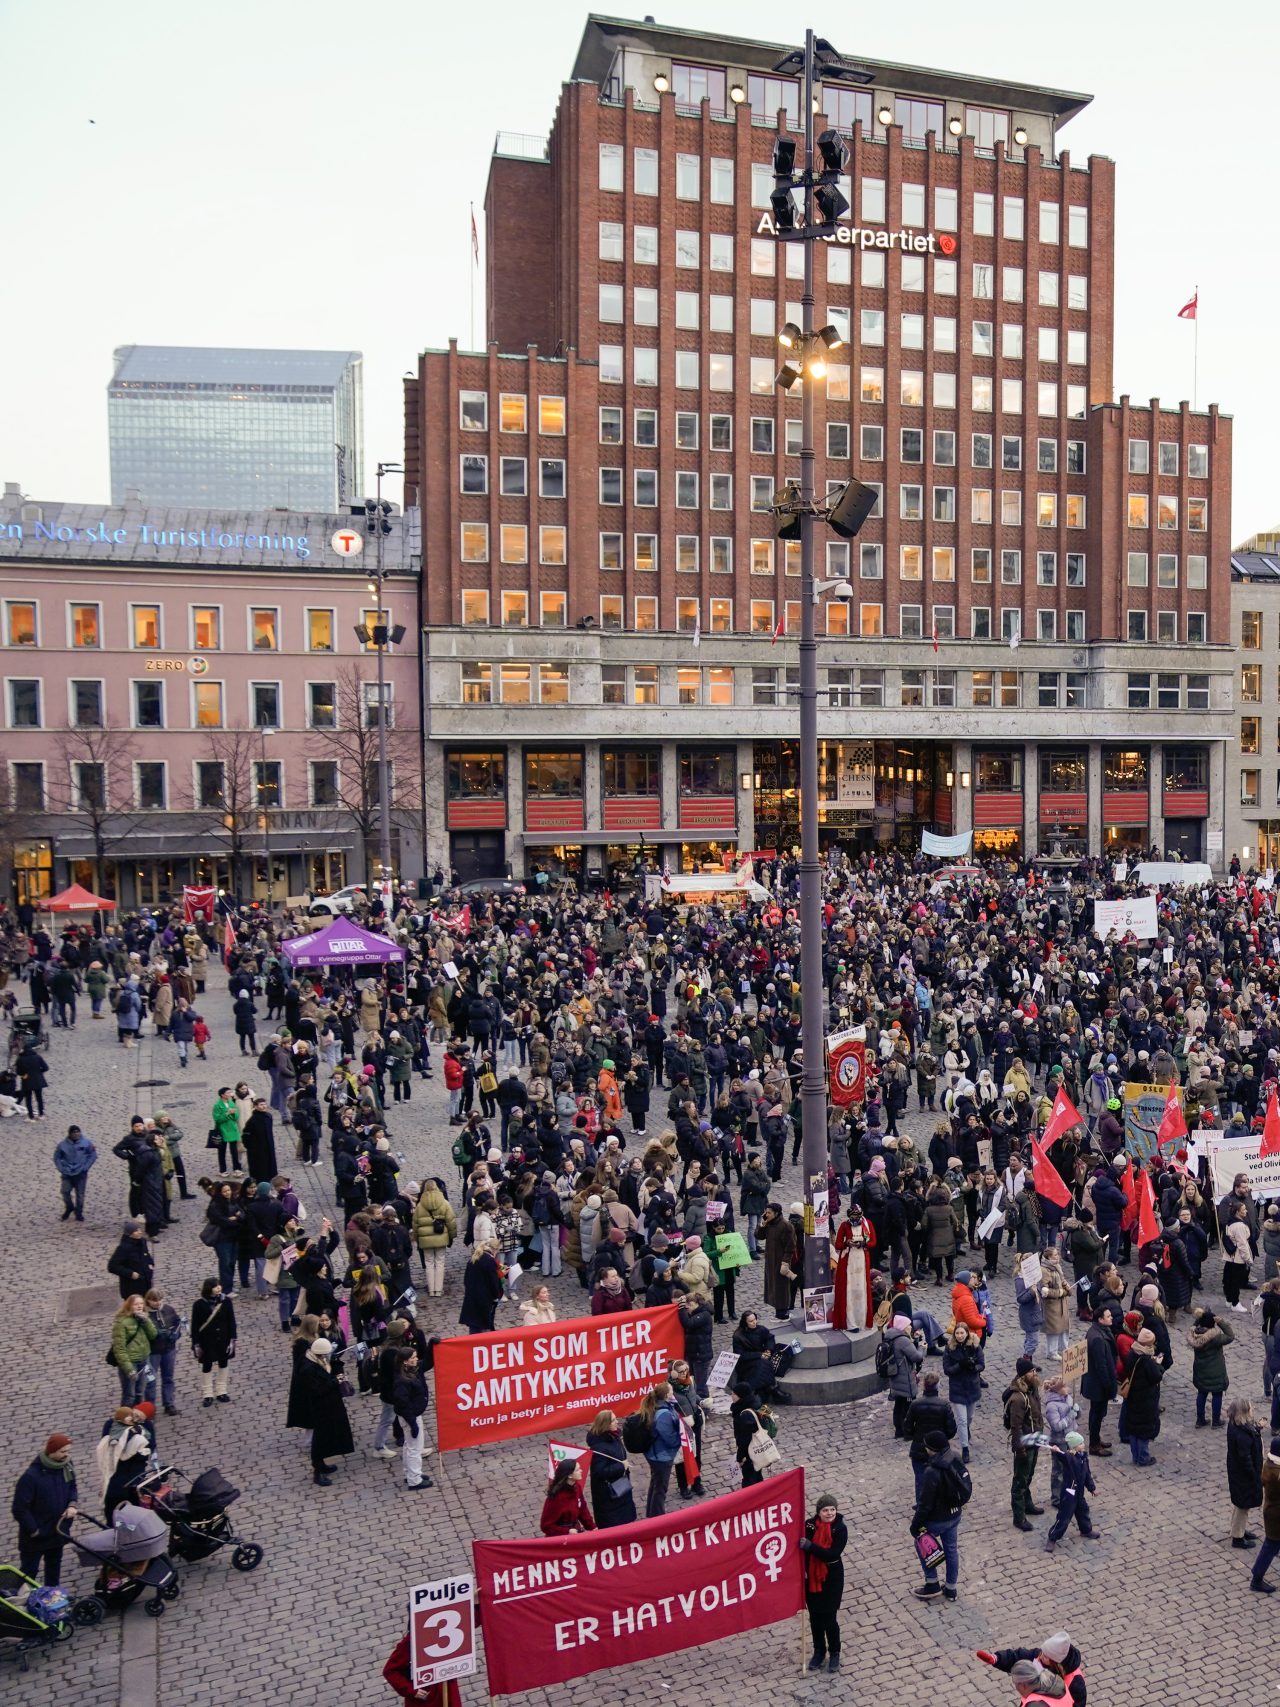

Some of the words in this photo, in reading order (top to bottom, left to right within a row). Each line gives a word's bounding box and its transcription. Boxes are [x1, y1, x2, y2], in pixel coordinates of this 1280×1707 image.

[756, 212, 936, 253] Aerpartiet
[35, 520, 127, 544] Norske
[136, 522, 311, 559] Turistforening
[145, 659, 184, 671] ZERO
[841, 774, 871, 782] CHESS
[318, 954, 364, 964] Kvinnegruppa
[1142, 1085, 1164, 1093] OSLO
[1244, 1153, 1261, 1161] Støt
[1249, 1162, 1263, 1170] ved
[473, 1340, 525, 1374] DEN
[533, 1331, 588, 1363] SOM
[597, 1319, 652, 1353] TIER
[456, 1361, 606, 1411] SAMTYKKER
[615, 1348, 669, 1383] IKKE
[470, 1415, 495, 1428] Kun
[497, 1412, 508, 1425] ja
[510, 1406, 541, 1421] betyr
[543, 1403, 554, 1419] ja
[566, 1388, 637, 1410] samtykkelov
[492, 1557, 577, 1595] MENNS
[584, 1542, 643, 1574] VOLD
[655, 1527, 700, 1558] MOT
[704, 1502, 794, 1546] KVINNER
[415, 1582, 470, 1605] Pulje
[554, 1616, 599, 1651] ER
[612, 1573, 757, 1637] HATVOLD
[423, 1610, 464, 1658] 3
[438, 1662, 470, 1677] OSLO
